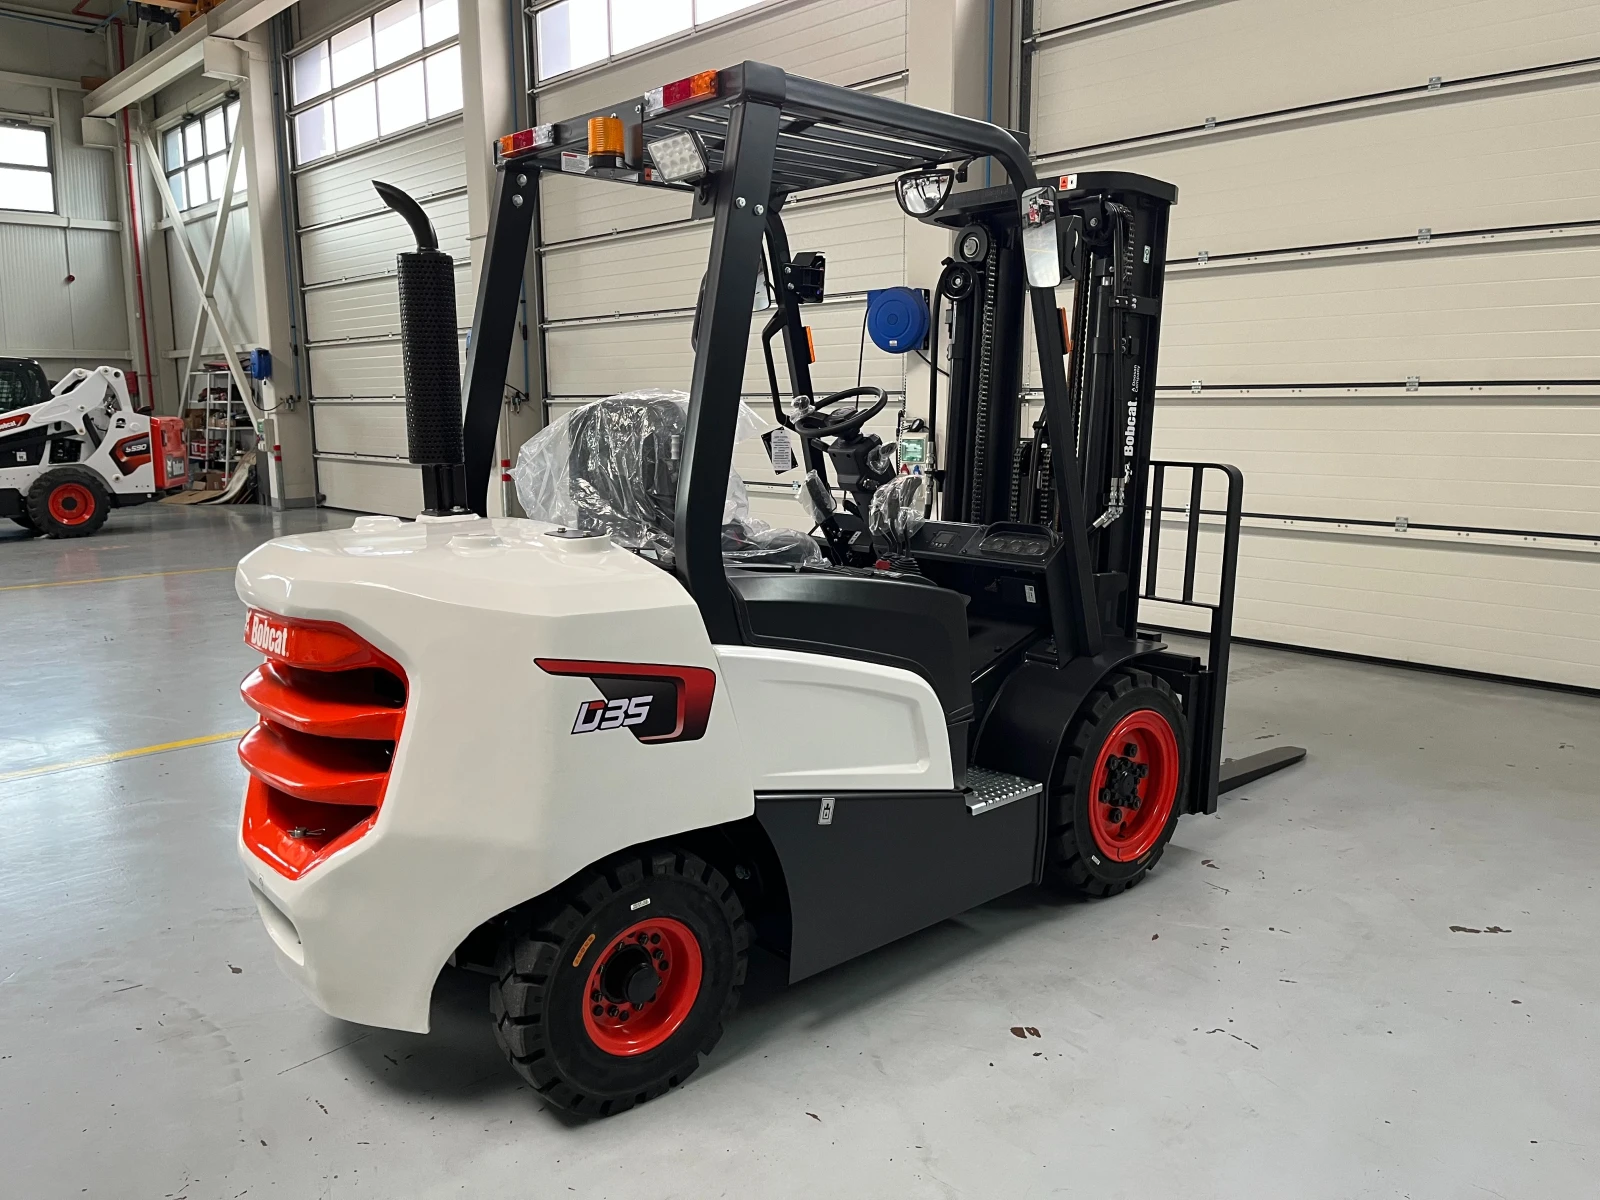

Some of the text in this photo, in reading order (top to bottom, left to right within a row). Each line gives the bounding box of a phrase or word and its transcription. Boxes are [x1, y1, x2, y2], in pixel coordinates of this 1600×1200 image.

[1123, 400, 1138, 457] Bobcat
[251, 615, 288, 657] Bobcat
[570, 695, 654, 735] D35
